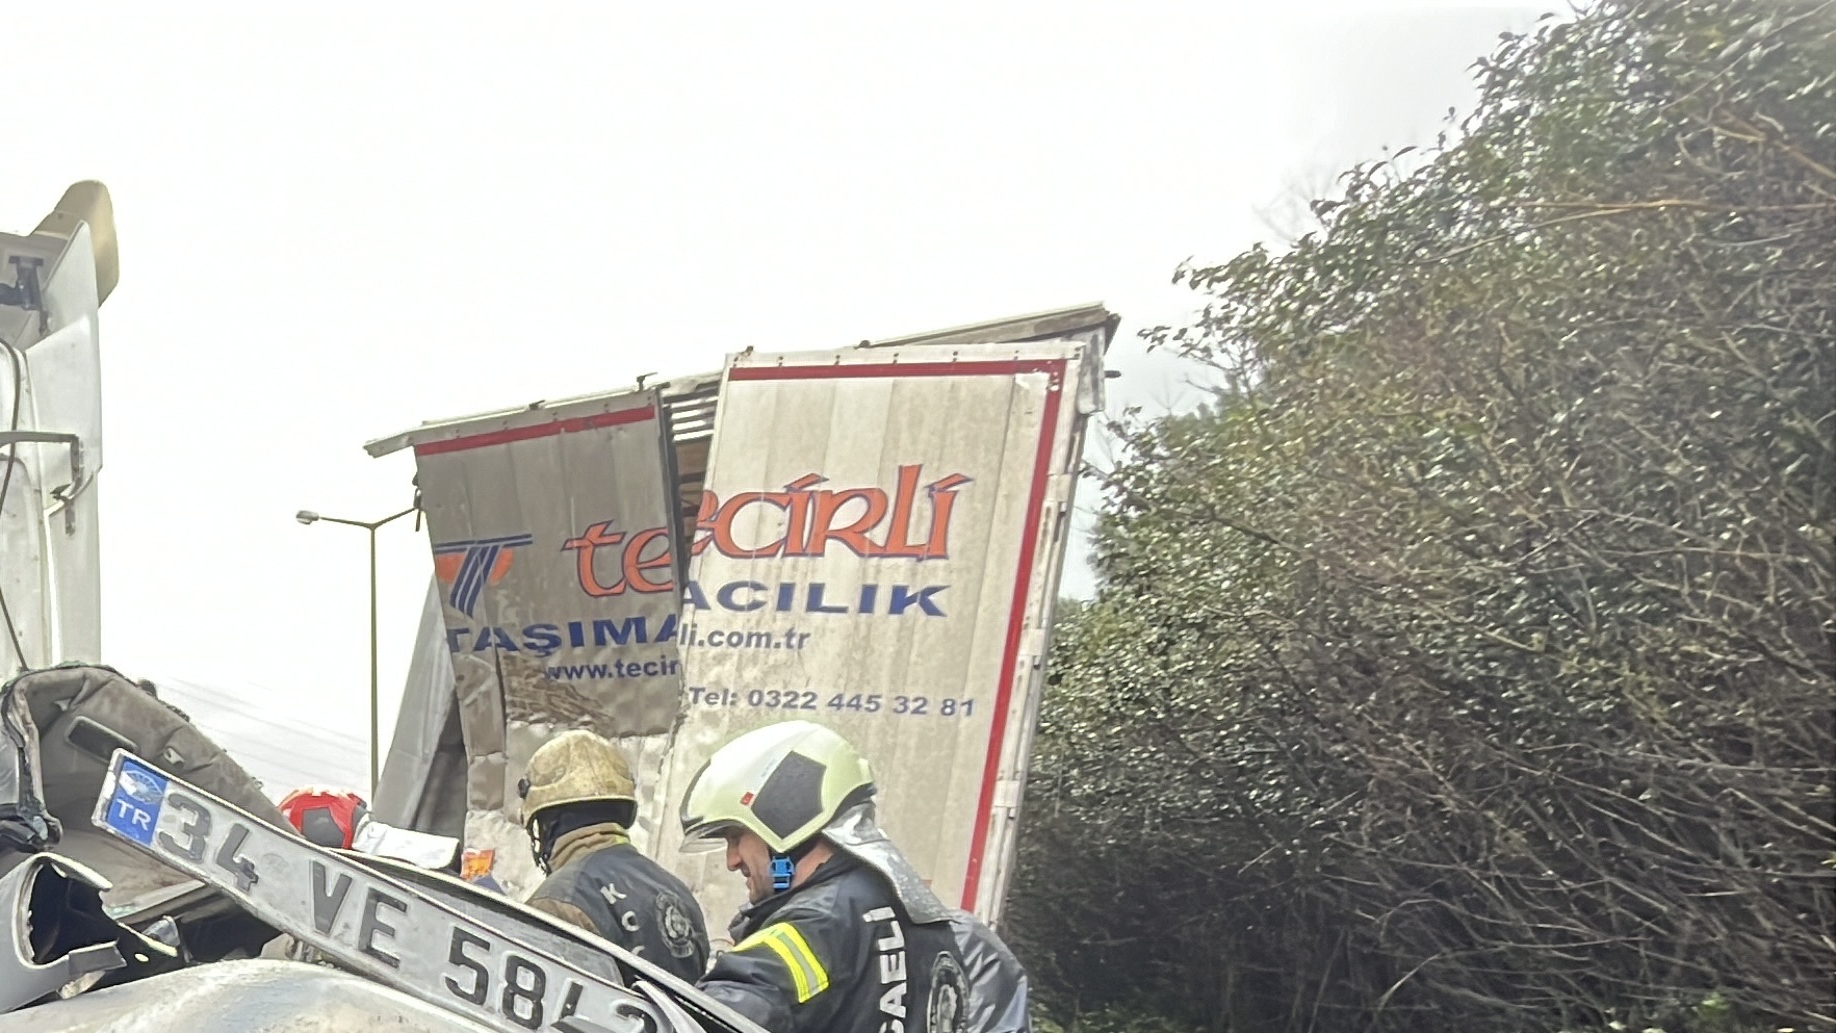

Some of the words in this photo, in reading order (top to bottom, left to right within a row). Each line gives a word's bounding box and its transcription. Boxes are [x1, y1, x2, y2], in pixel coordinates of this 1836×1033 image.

[689, 686, 737, 706] Tel:
[748, 689, 818, 710] 0322
[828, 694, 882, 713] 445
[893, 696, 928, 716] 32
[940, 699, 975, 717] 81
[116, 798, 152, 831] TR
[159, 792, 260, 892] 34
[311, 859, 409, 969] VE
